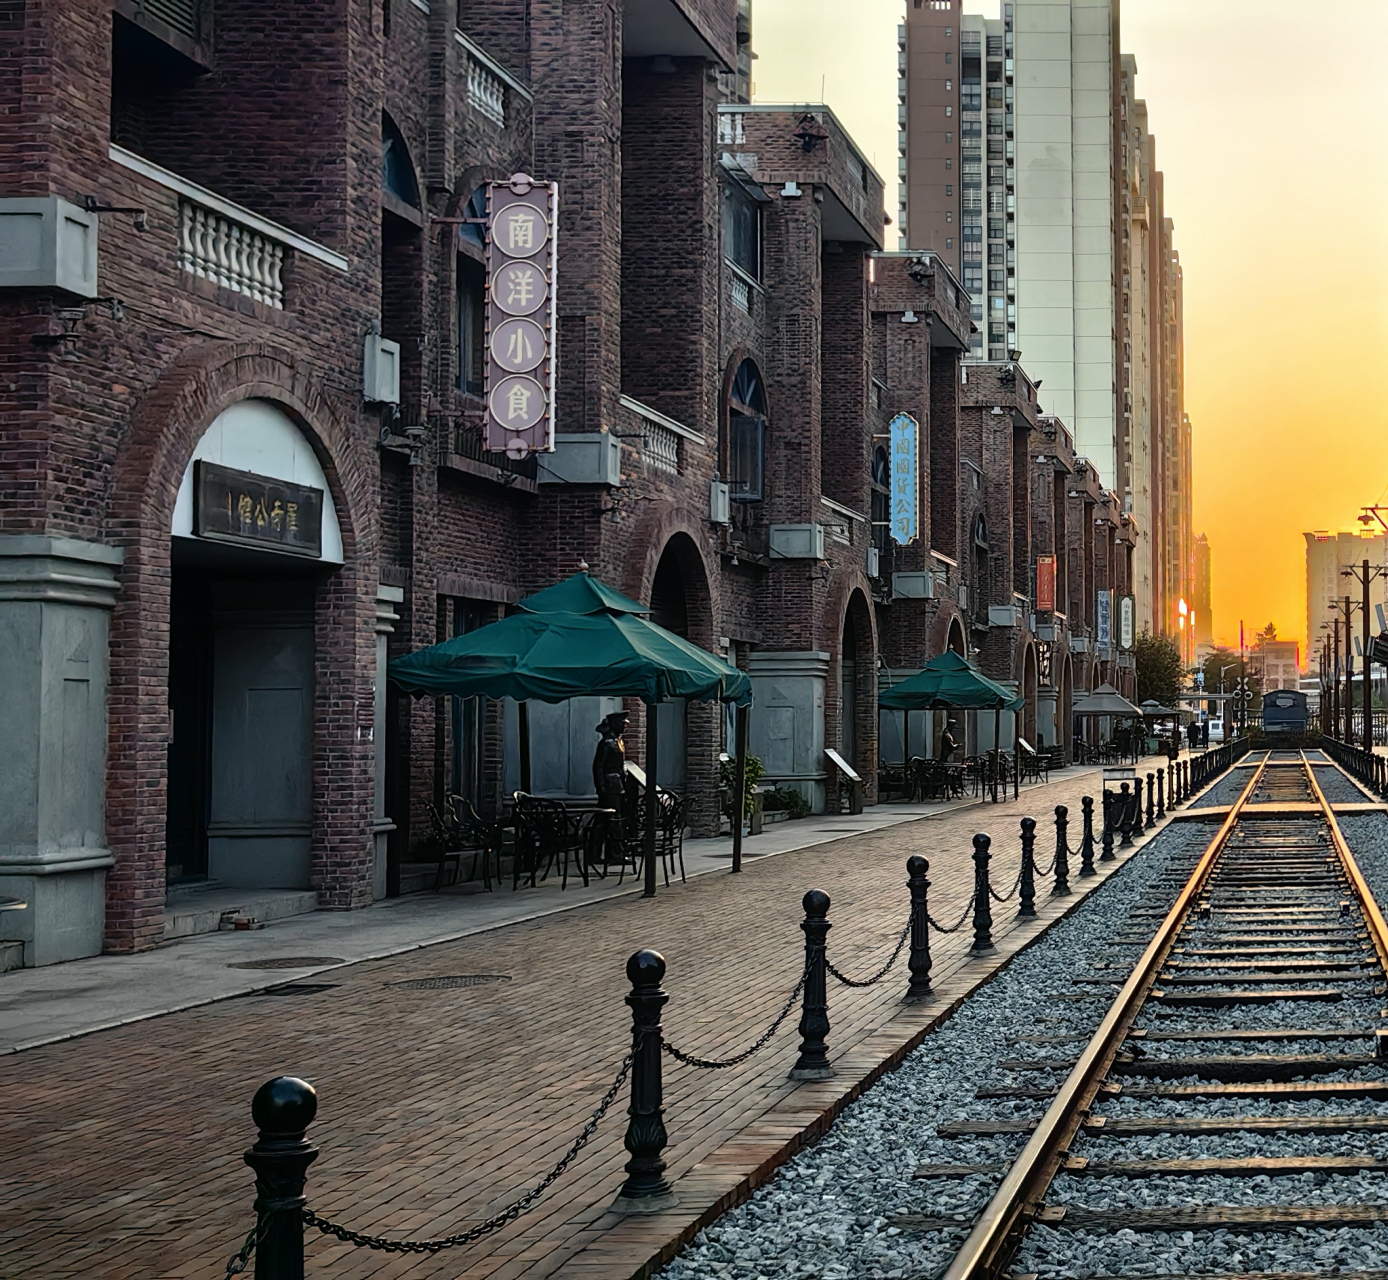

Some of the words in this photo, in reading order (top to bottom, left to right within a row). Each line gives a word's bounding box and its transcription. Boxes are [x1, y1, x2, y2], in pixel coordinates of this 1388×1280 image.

[506, 213, 534, 420] 南洋小食
[896, 419, 910, 536] 中國國貨公司
